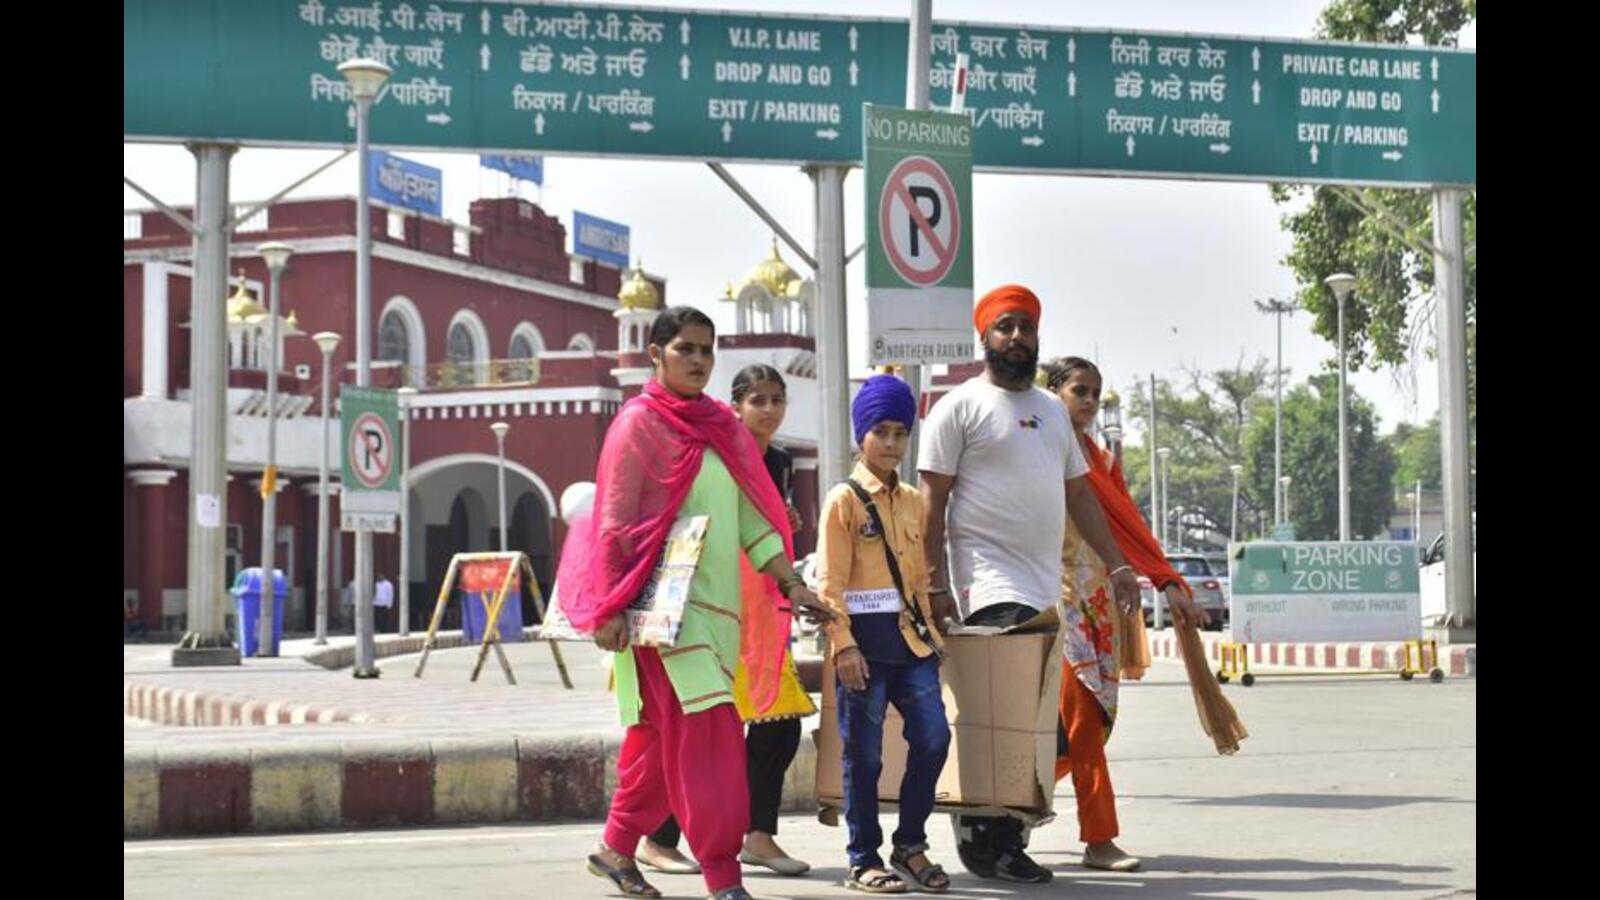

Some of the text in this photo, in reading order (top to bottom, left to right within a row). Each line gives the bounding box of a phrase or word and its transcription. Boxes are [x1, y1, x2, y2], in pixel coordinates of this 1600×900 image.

[775, 30, 821, 51] LANE
[715, 61, 832, 86] DROP AND GO
[1282, 54, 1421, 80] PRIVATE CAR LANE
[708, 98, 748, 119] EXIT
[764, 100, 840, 124] PARKING
[1300, 87, 1401, 111] DROP AND GO
[866, 118, 971, 147] NO PARKING
[1297, 122, 1331, 143] EXIT
[1343, 124, 1409, 147] PARKING
[1294, 546, 1403, 566] PARKING
[1291, 570, 1361, 591] ZONE
